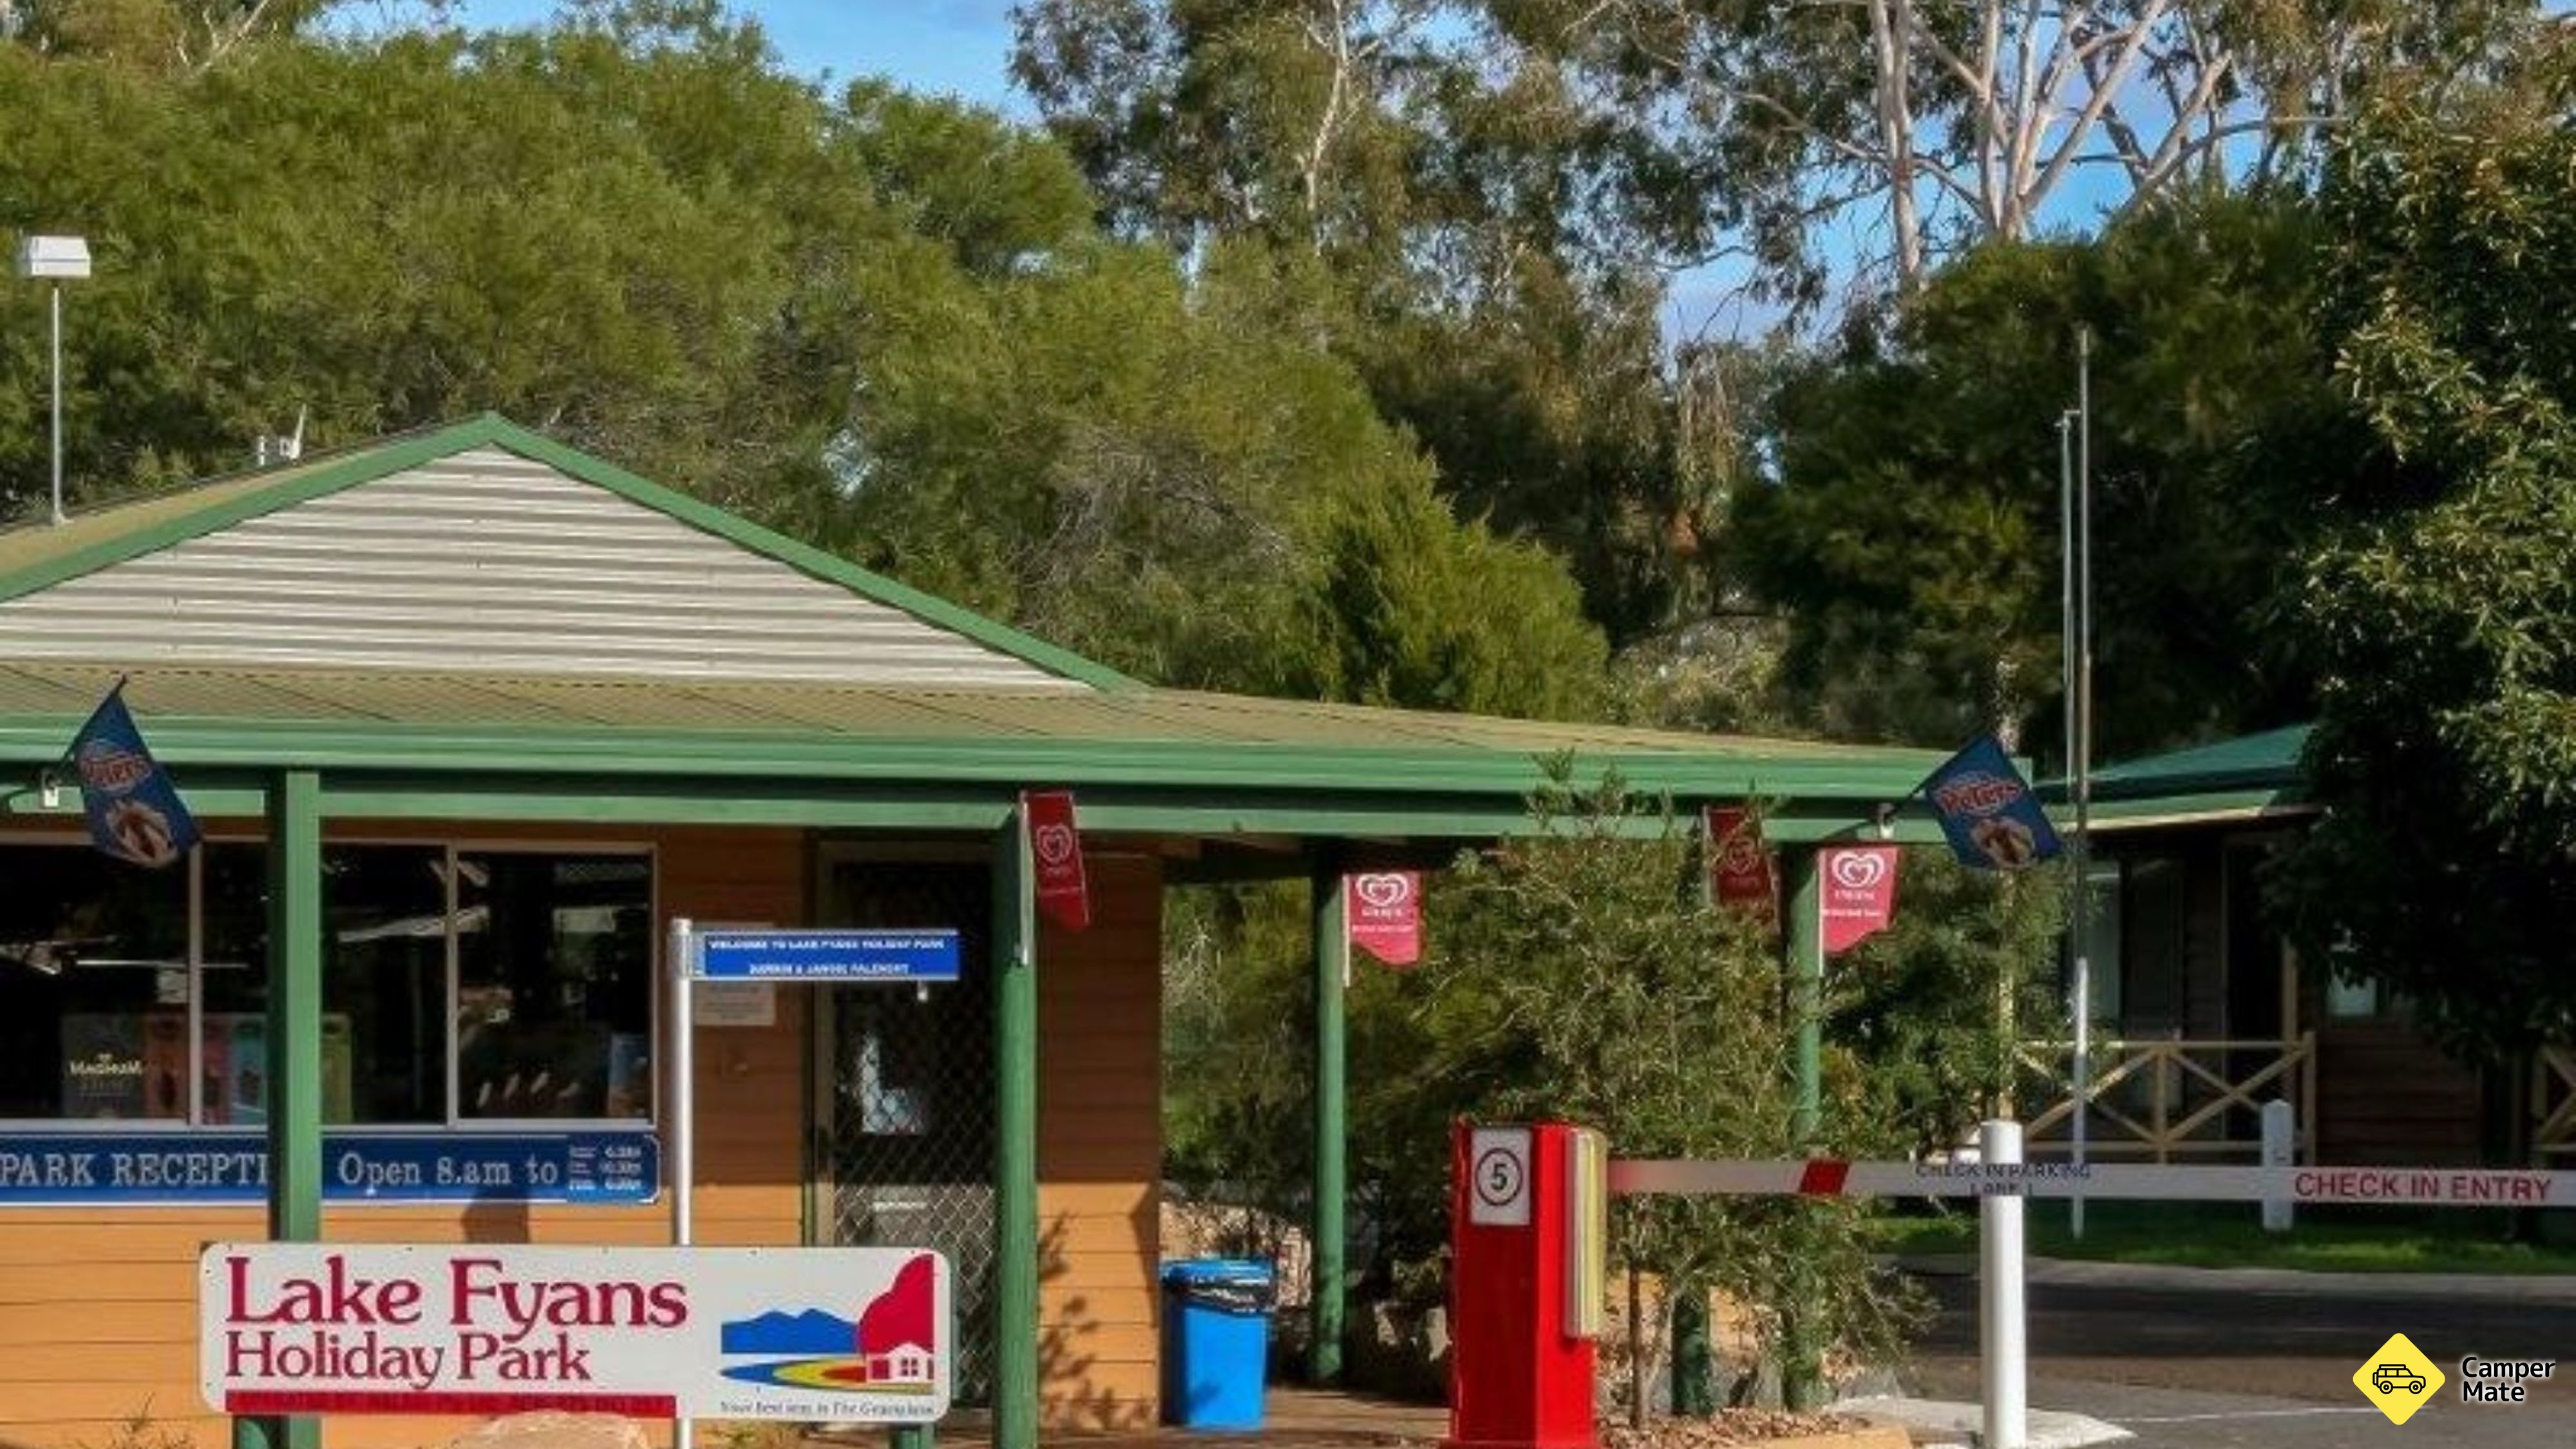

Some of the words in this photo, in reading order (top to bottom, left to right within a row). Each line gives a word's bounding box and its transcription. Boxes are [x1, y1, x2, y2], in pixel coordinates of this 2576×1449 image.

[0, 1153, 95, 1187] PARK
[111, 1152, 268, 1187] RECEPTI
[339, 1153, 422, 1195] Open
[526, 1153, 558, 1185] to
[1490, 1162, 1508, 1191] 5
[1915, 1163, 1980, 1178] CHECK
[1987, 1163, 2003, 1178] IN
[2008, 1163, 2091, 1179] PARKING
[2295, 1172, 2399, 1197] CHECK
[2411, 1174, 2439, 1198] IN
[2452, 1175, 2552, 1201] ENTRY
[225, 1255, 423, 1325] Lake
[450, 1258, 688, 1342] Fyans
[225, 1330, 444, 1389] Holiday
[457, 1332, 592, 1381] Park
